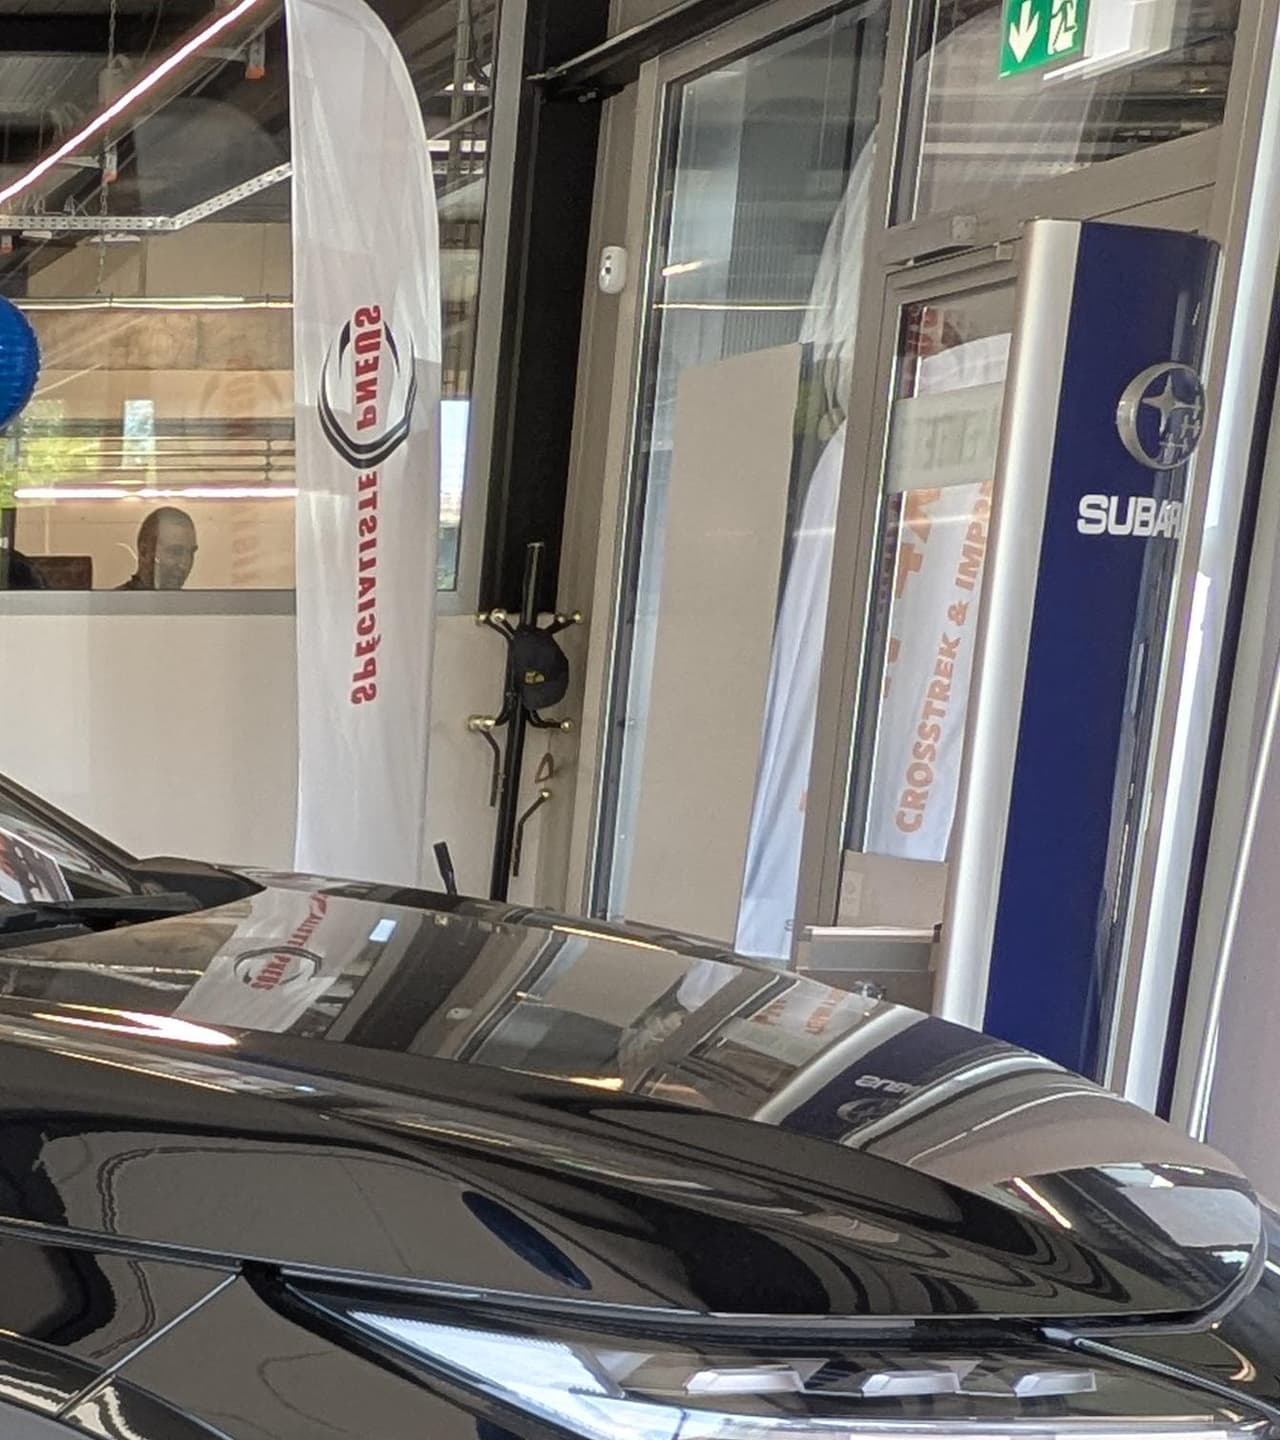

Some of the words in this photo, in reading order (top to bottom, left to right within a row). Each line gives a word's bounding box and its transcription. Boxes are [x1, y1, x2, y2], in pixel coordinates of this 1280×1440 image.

[1076, 493, 1183, 540] SUBAR
[895, 635, 962, 833] CROSSTREK
[947, 599, 969, 627] &
